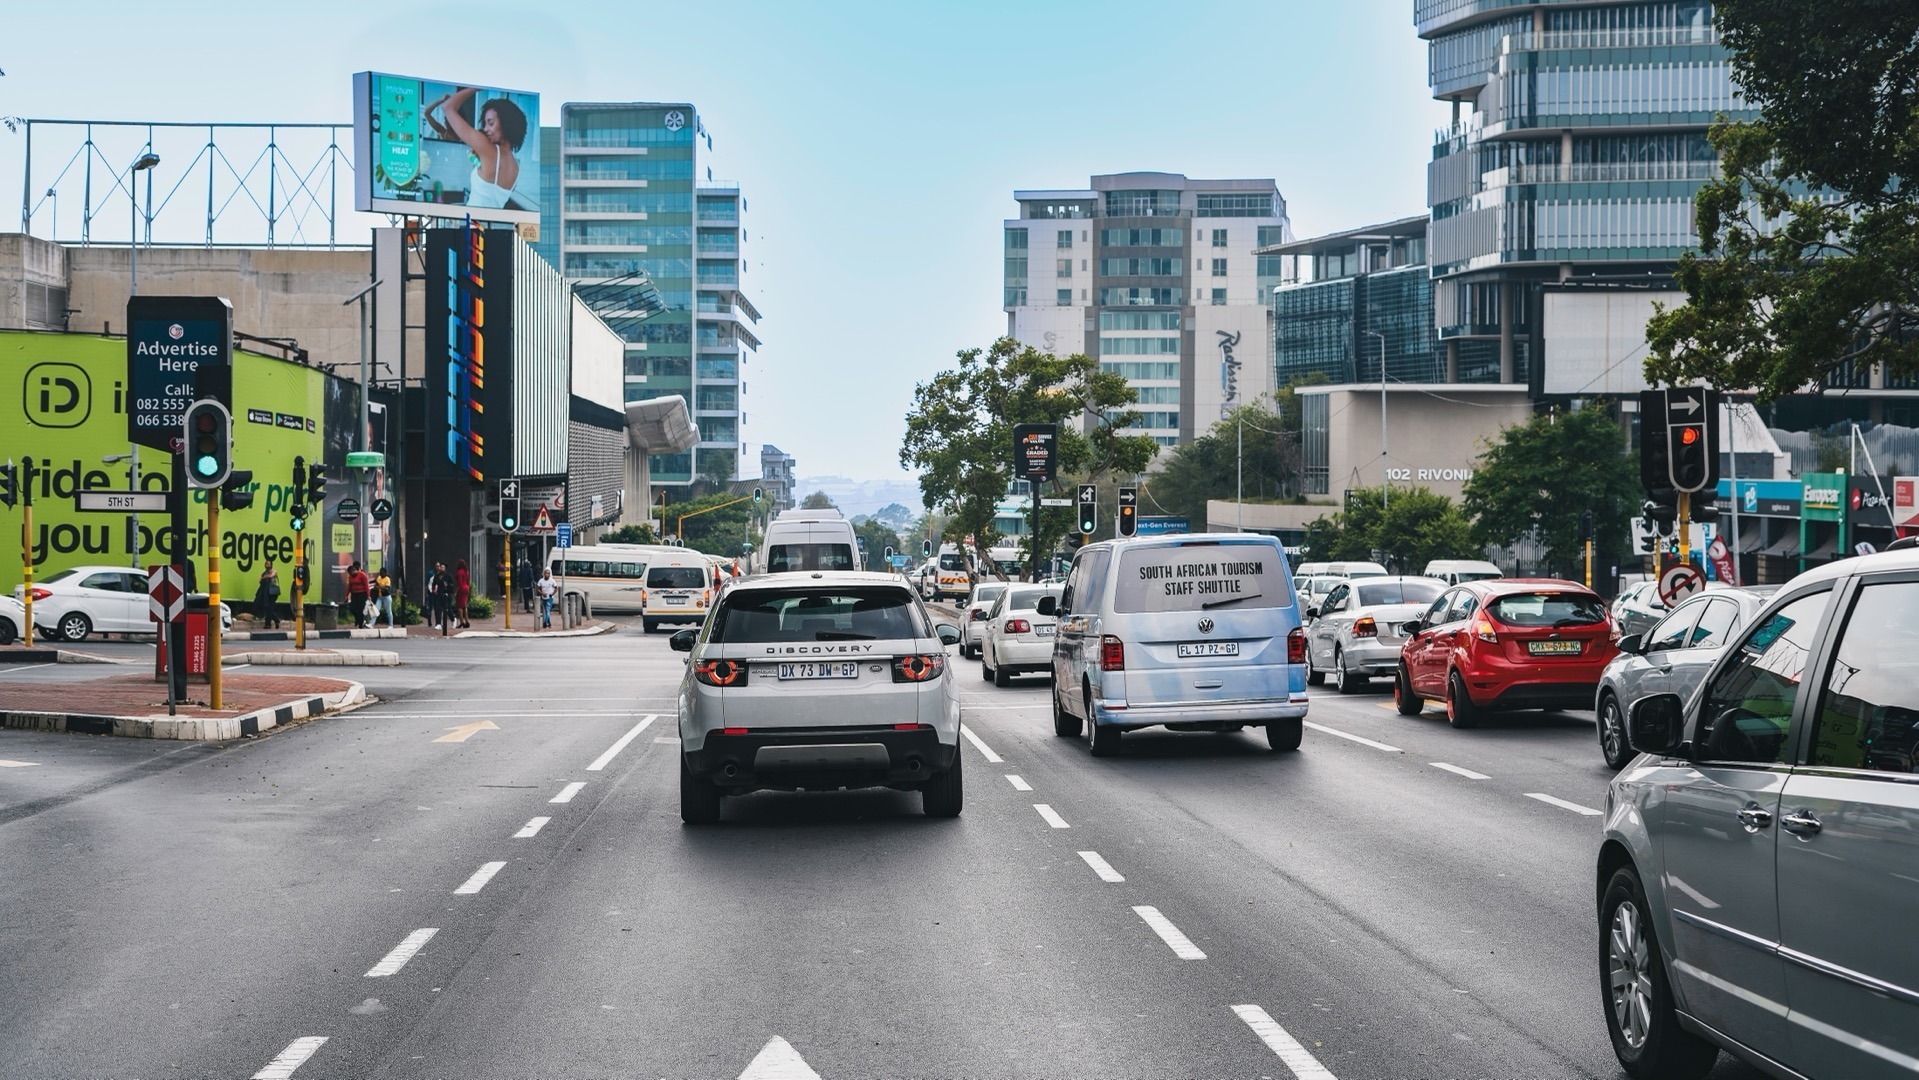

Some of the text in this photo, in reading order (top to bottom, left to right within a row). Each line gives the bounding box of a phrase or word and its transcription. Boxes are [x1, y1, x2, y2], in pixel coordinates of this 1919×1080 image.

[392, 146, 408, 155] HEAT
[137, 341, 218, 355] Advertise
[160, 358, 198, 371] Here
[1216, 330, 1242, 402] Radisson
[165, 384, 194, 395] Call:
[137, 399, 159, 410] 082
[162, 399, 184, 410] 555
[137, 414, 184, 426] 066 538
[1386, 468, 1410, 480] 102
[108, 498, 134, 507] 5TH ST
[1804, 485, 1840, 508] Europcar
[22, 524, 109, 564] you
[222, 531, 293, 572] agree
[1140, 562, 1263, 580] SOUTH AFRICAN TOURISM
[1165, 580, 1241, 596] STAFF SHUTTLE
[766, 645, 872, 654] DISCOVERY
[1180, 644, 1236, 654] FL 17 PZ GP
[781, 664, 795, 677] DX
[800, 664, 813, 676] 73
[819, 664, 832, 676] DW
[842, 663, 855, 676] GP
[47, 718, 59, 730] ST
